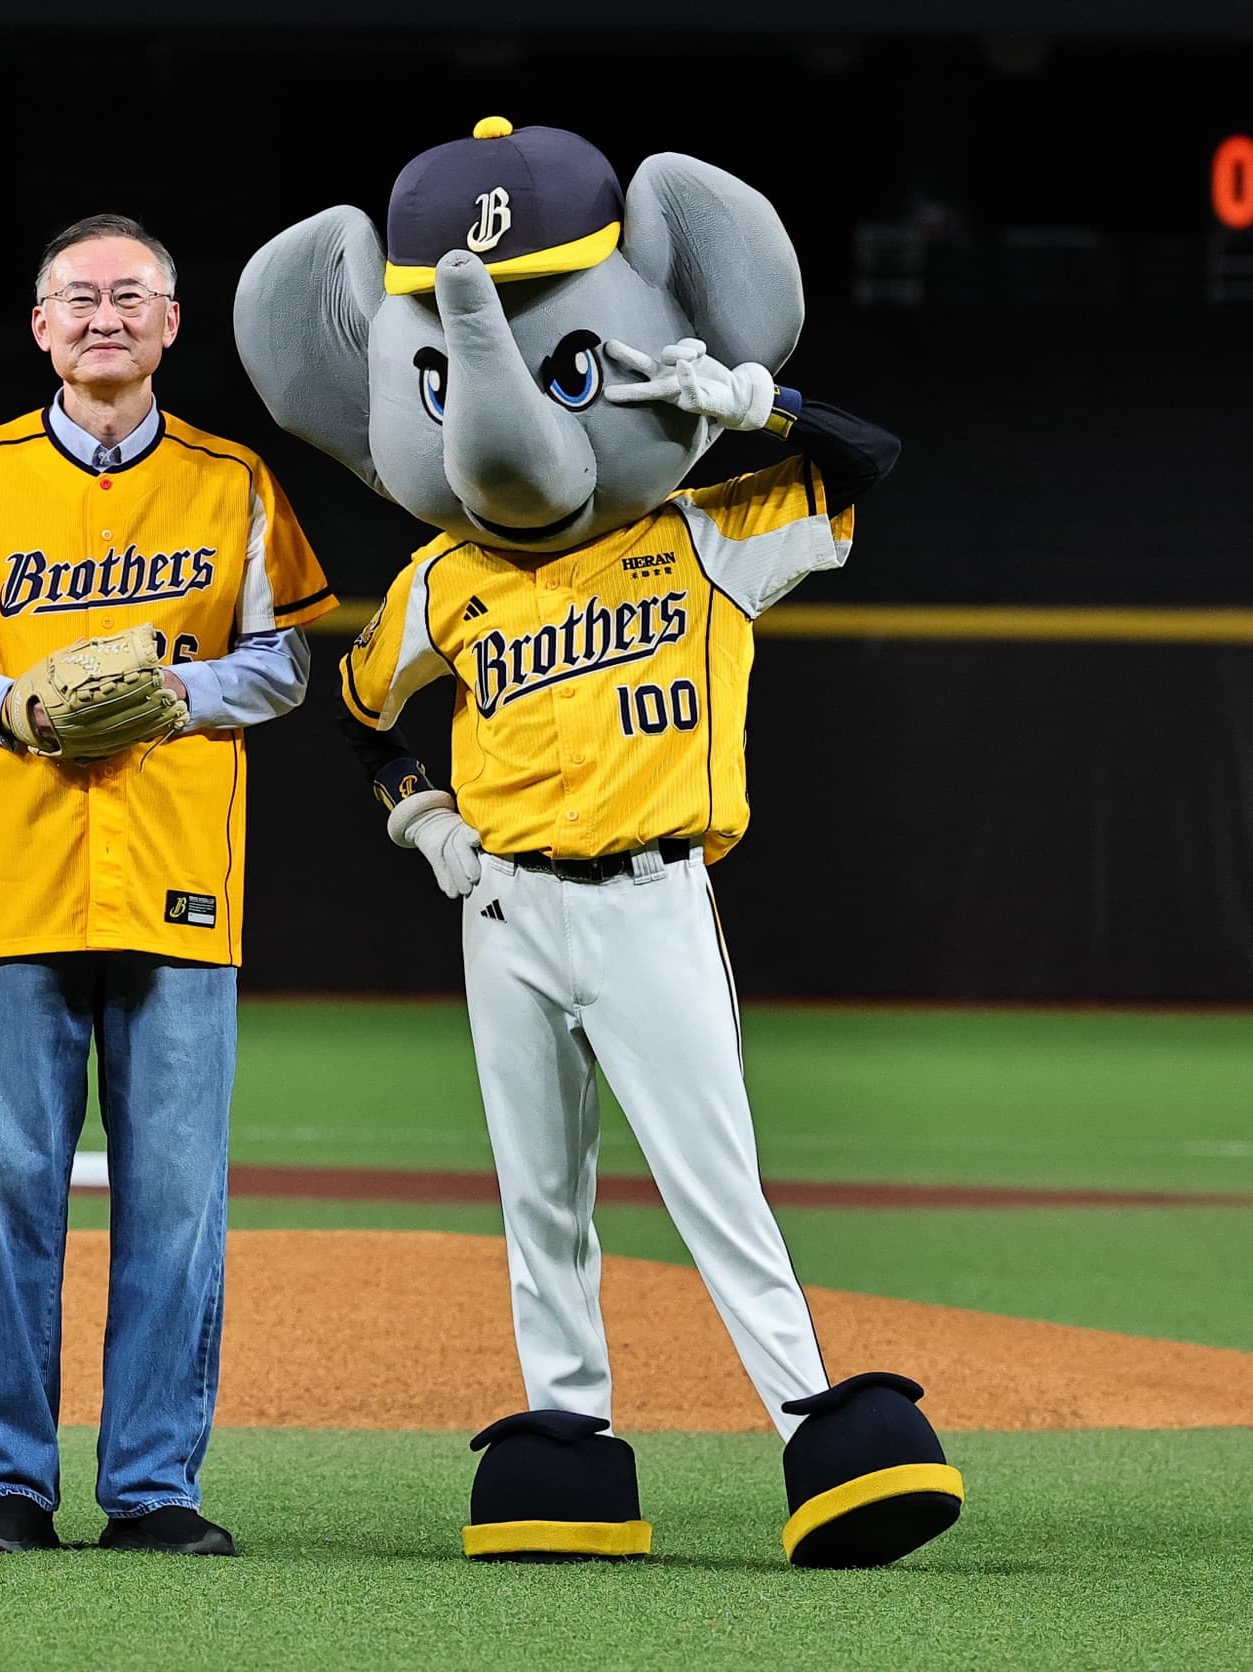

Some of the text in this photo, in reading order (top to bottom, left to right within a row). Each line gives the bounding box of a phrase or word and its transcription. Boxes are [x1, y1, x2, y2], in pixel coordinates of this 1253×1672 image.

[467, 186, 511, 252] B
[0, 544, 217, 618] Brothers
[621, 551, 676, 571] HERAN
[471, 589, 688, 720] Brothers
[617, 678, 700, 737] 100
[169, 897, 187, 918] B
